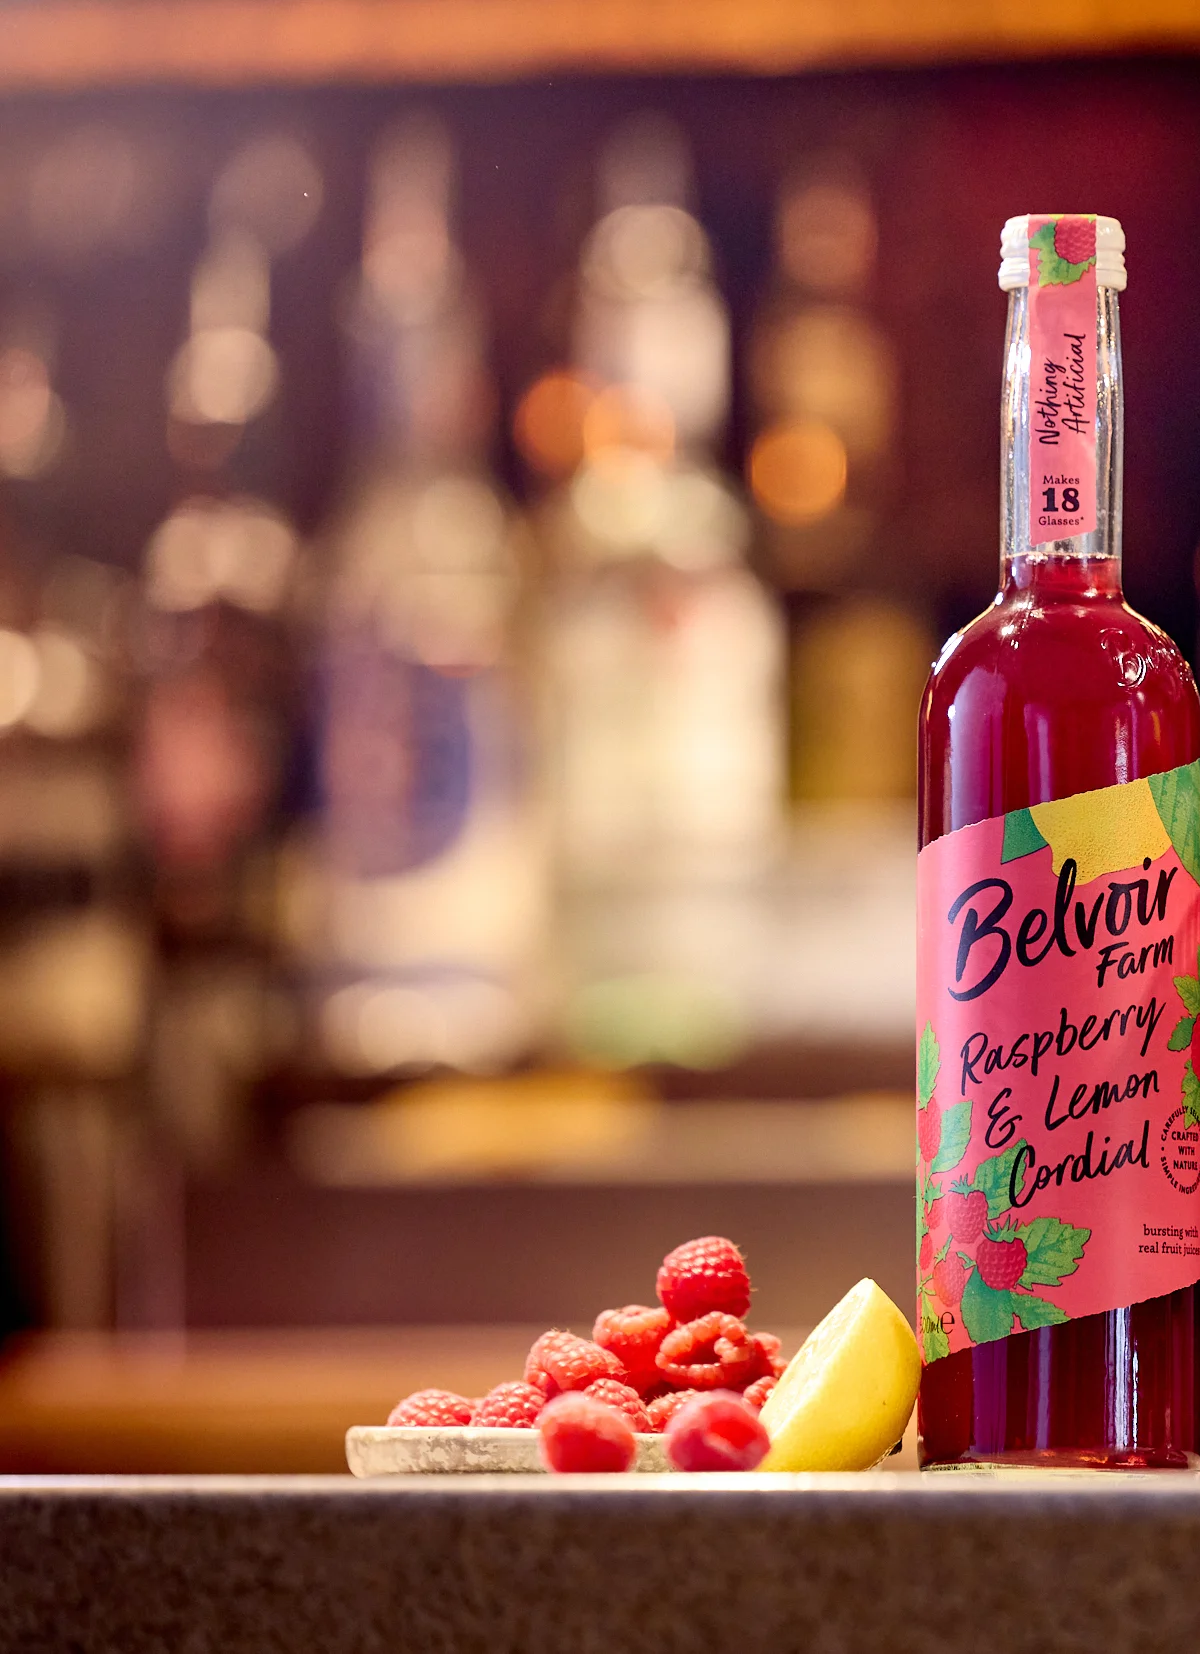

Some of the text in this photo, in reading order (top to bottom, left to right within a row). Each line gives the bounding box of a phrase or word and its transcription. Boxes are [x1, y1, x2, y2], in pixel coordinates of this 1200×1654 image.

[1035, 357, 1067, 445] Nothing
[1061, 333, 1091, 434] Artificial
[1042, 474, 1081, 485] Makes
[1042, 487, 1080, 513] 18
[947, 856, 1179, 1002] Belvoir
[1095, 935, 1174, 989] Farm
[960, 997, 1167, 1096] Raspberry
[984, 1070, 1160, 1149] & Lemon
[1160, 1105, 1189, 1142] CAREFULLY
[1171, 1130, 1199, 1142] CRAFTED
[1177, 1145, 1196, 1156] WITH
[1008, 1119, 1150, 1209] Cordial
[1160, 1156, 1179, 1189] SIMPLE
[1173, 1159, 1199, 1171] NATURE
[1138, 1241, 1160, 1254] real
[1161, 1241, 1183, 1255] fruit
[1142, 1223, 1199, 1240] bursting with
